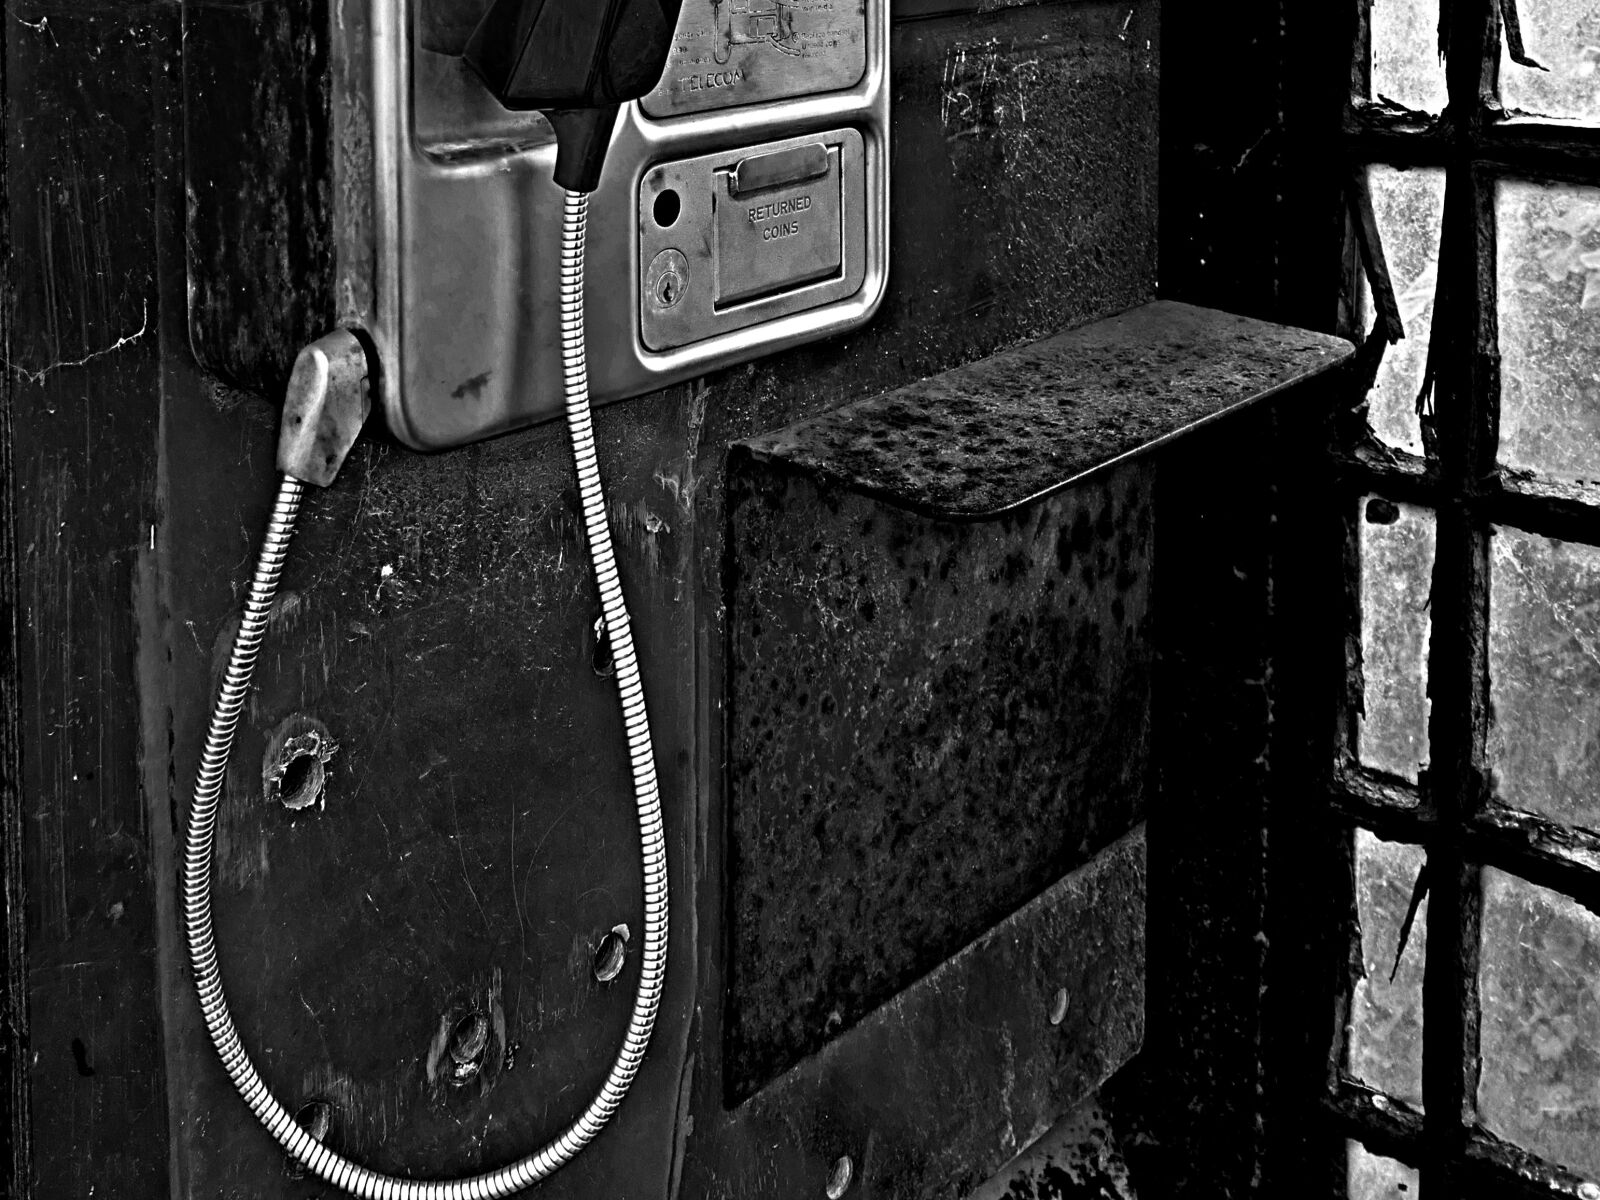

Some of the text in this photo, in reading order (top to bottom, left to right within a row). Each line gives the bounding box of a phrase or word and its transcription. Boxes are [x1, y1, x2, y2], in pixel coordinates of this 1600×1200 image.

[677, 69, 747, 92] TELECOM
[748, 196, 812, 224] RETURNED
[763, 221, 800, 242] COINS
